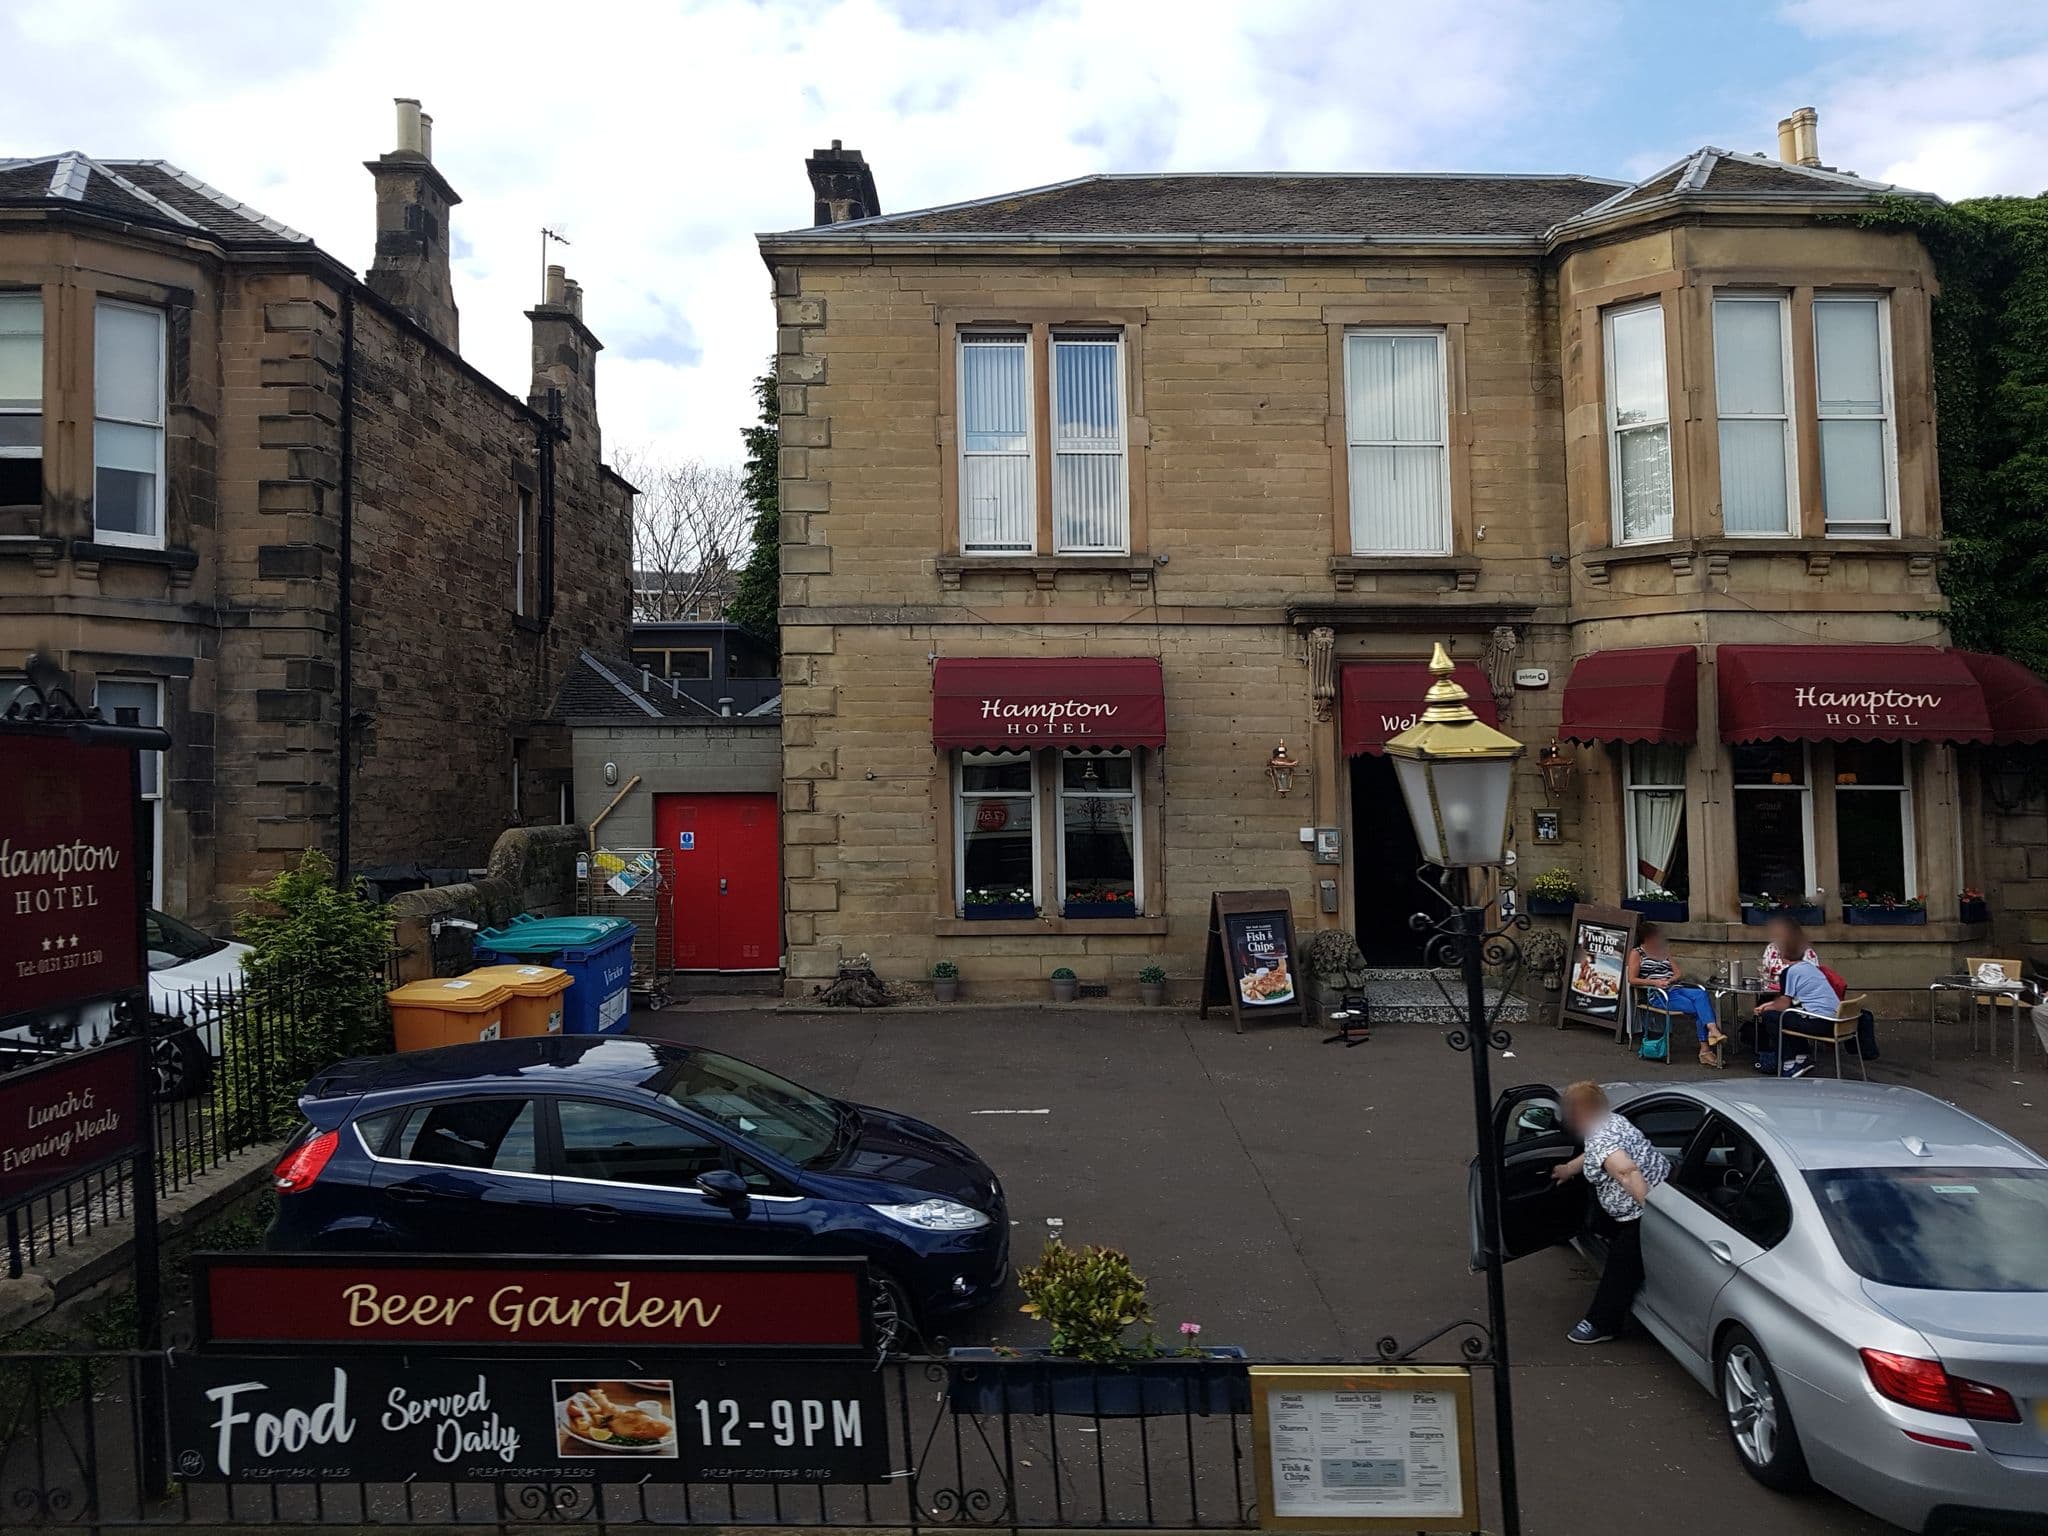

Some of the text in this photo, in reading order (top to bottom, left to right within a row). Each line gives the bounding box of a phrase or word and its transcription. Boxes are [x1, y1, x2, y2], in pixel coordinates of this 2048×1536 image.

[981, 698, 1118, 722] Hampton
[1795, 686, 1941, 712] Hampton
[1007, 723, 1091, 734] HOTEL
[1826, 713, 1918, 726] HOTEL
[14, 885, 98, 915] HOTEL
[1246, 932, 1266, 942] Fish
[1247, 942, 1274, 953] Chips
[1587, 932, 1619, 946] Two For
[27, 1088, 96, 1129] Lunch &
[2, 1108, 120, 1172] Evening Meals
[343, 1281, 722, 1333] Beer Garden
[381, 1374, 491, 1433] Served
[205, 1366, 356, 1475] Food
[432, 1416, 521, 1464] Daily
